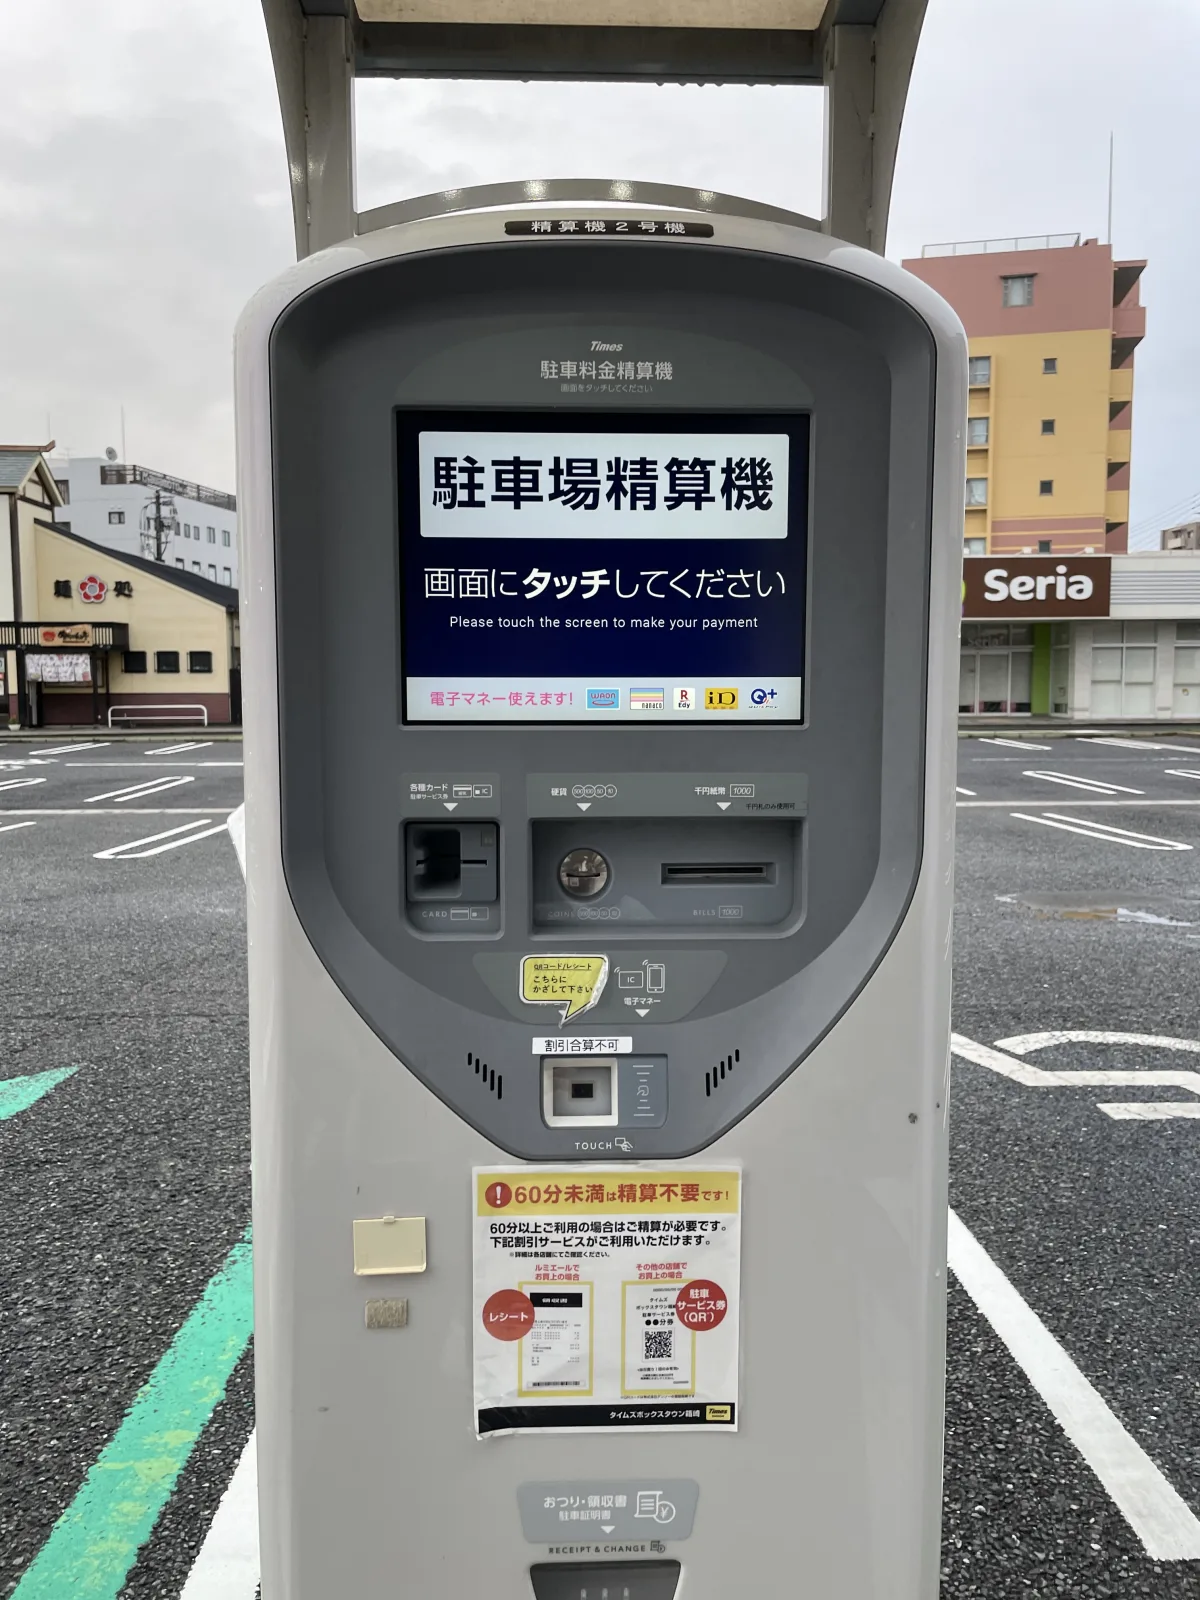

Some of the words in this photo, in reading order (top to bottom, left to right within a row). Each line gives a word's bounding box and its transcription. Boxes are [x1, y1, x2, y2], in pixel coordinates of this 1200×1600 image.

[531, 220, 686, 234] 精算機2号機
[590, 340, 623, 351] Times
[540, 360, 673, 380] 駐車料金精算機
[560, 383, 653, 393] 画面をタッチしてください
[432, 455, 774, 511] 駐車場精算機
[424, 567, 786, 600] 画面にタッチしてください
[984, 564, 1093, 601] Seria
[450, 615, 494, 628] Please
[498, 615, 535, 628] touch
[540, 615, 561, 628] the
[565, 617, 609, 628] screen
[613, 617, 626, 628] to
[630, 615, 665, 628] make
[669, 619, 698, 631] your
[702, 617, 758, 631] payment
[430, 691, 573, 706] 電子マネー使えます!
[708, 691, 736, 705] iD
[409, 783, 449, 792] 各種カード
[551, 787, 568, 796] 硬貨
[694, 786, 726, 795] 千円紙幣
[733, 786, 752, 795] 1000
[745, 802, 796, 811] 千円札のみ使用可
[421, 910, 448, 918] CARD
[533, 975, 567, 984] こちらに
[532, 985, 593, 994] かざして下さい
[624, 997, 661, 1006] 電子マネー
[544, 1038, 620, 1053] 割引合算不可
[575, 1142, 612, 1150] TOUCH
[514, 1183, 729, 1204] 60分未満は精算不要です!
[490, 1220, 727, 1235] 60分以上ご利用の場合はご精算が必要です。
[490, 1234, 711, 1249] 下記割引サービスがご利用いただけます。
[534, 1264, 580, 1272] ルミエールで
[635, 1262, 688, 1271] その他の店舗で
[534, 1273, 580, 1281] お買上の場合
[638, 1271, 683, 1280] お買上の場合
[689, 1288, 709, 1299] 駐車
[677, 1300, 726, 1311] サービス券
[489, 1311, 529, 1322] レシート
[609, 1409, 701, 1419] タイムズボックスタウン箱崎
[543, 1494, 628, 1508] おつり・領収書
[558, 1509, 611, 1521] 駐車証明書
[549, 1546, 591, 1554] RECEIPT
[603, 1545, 646, 1553] CHANGE
